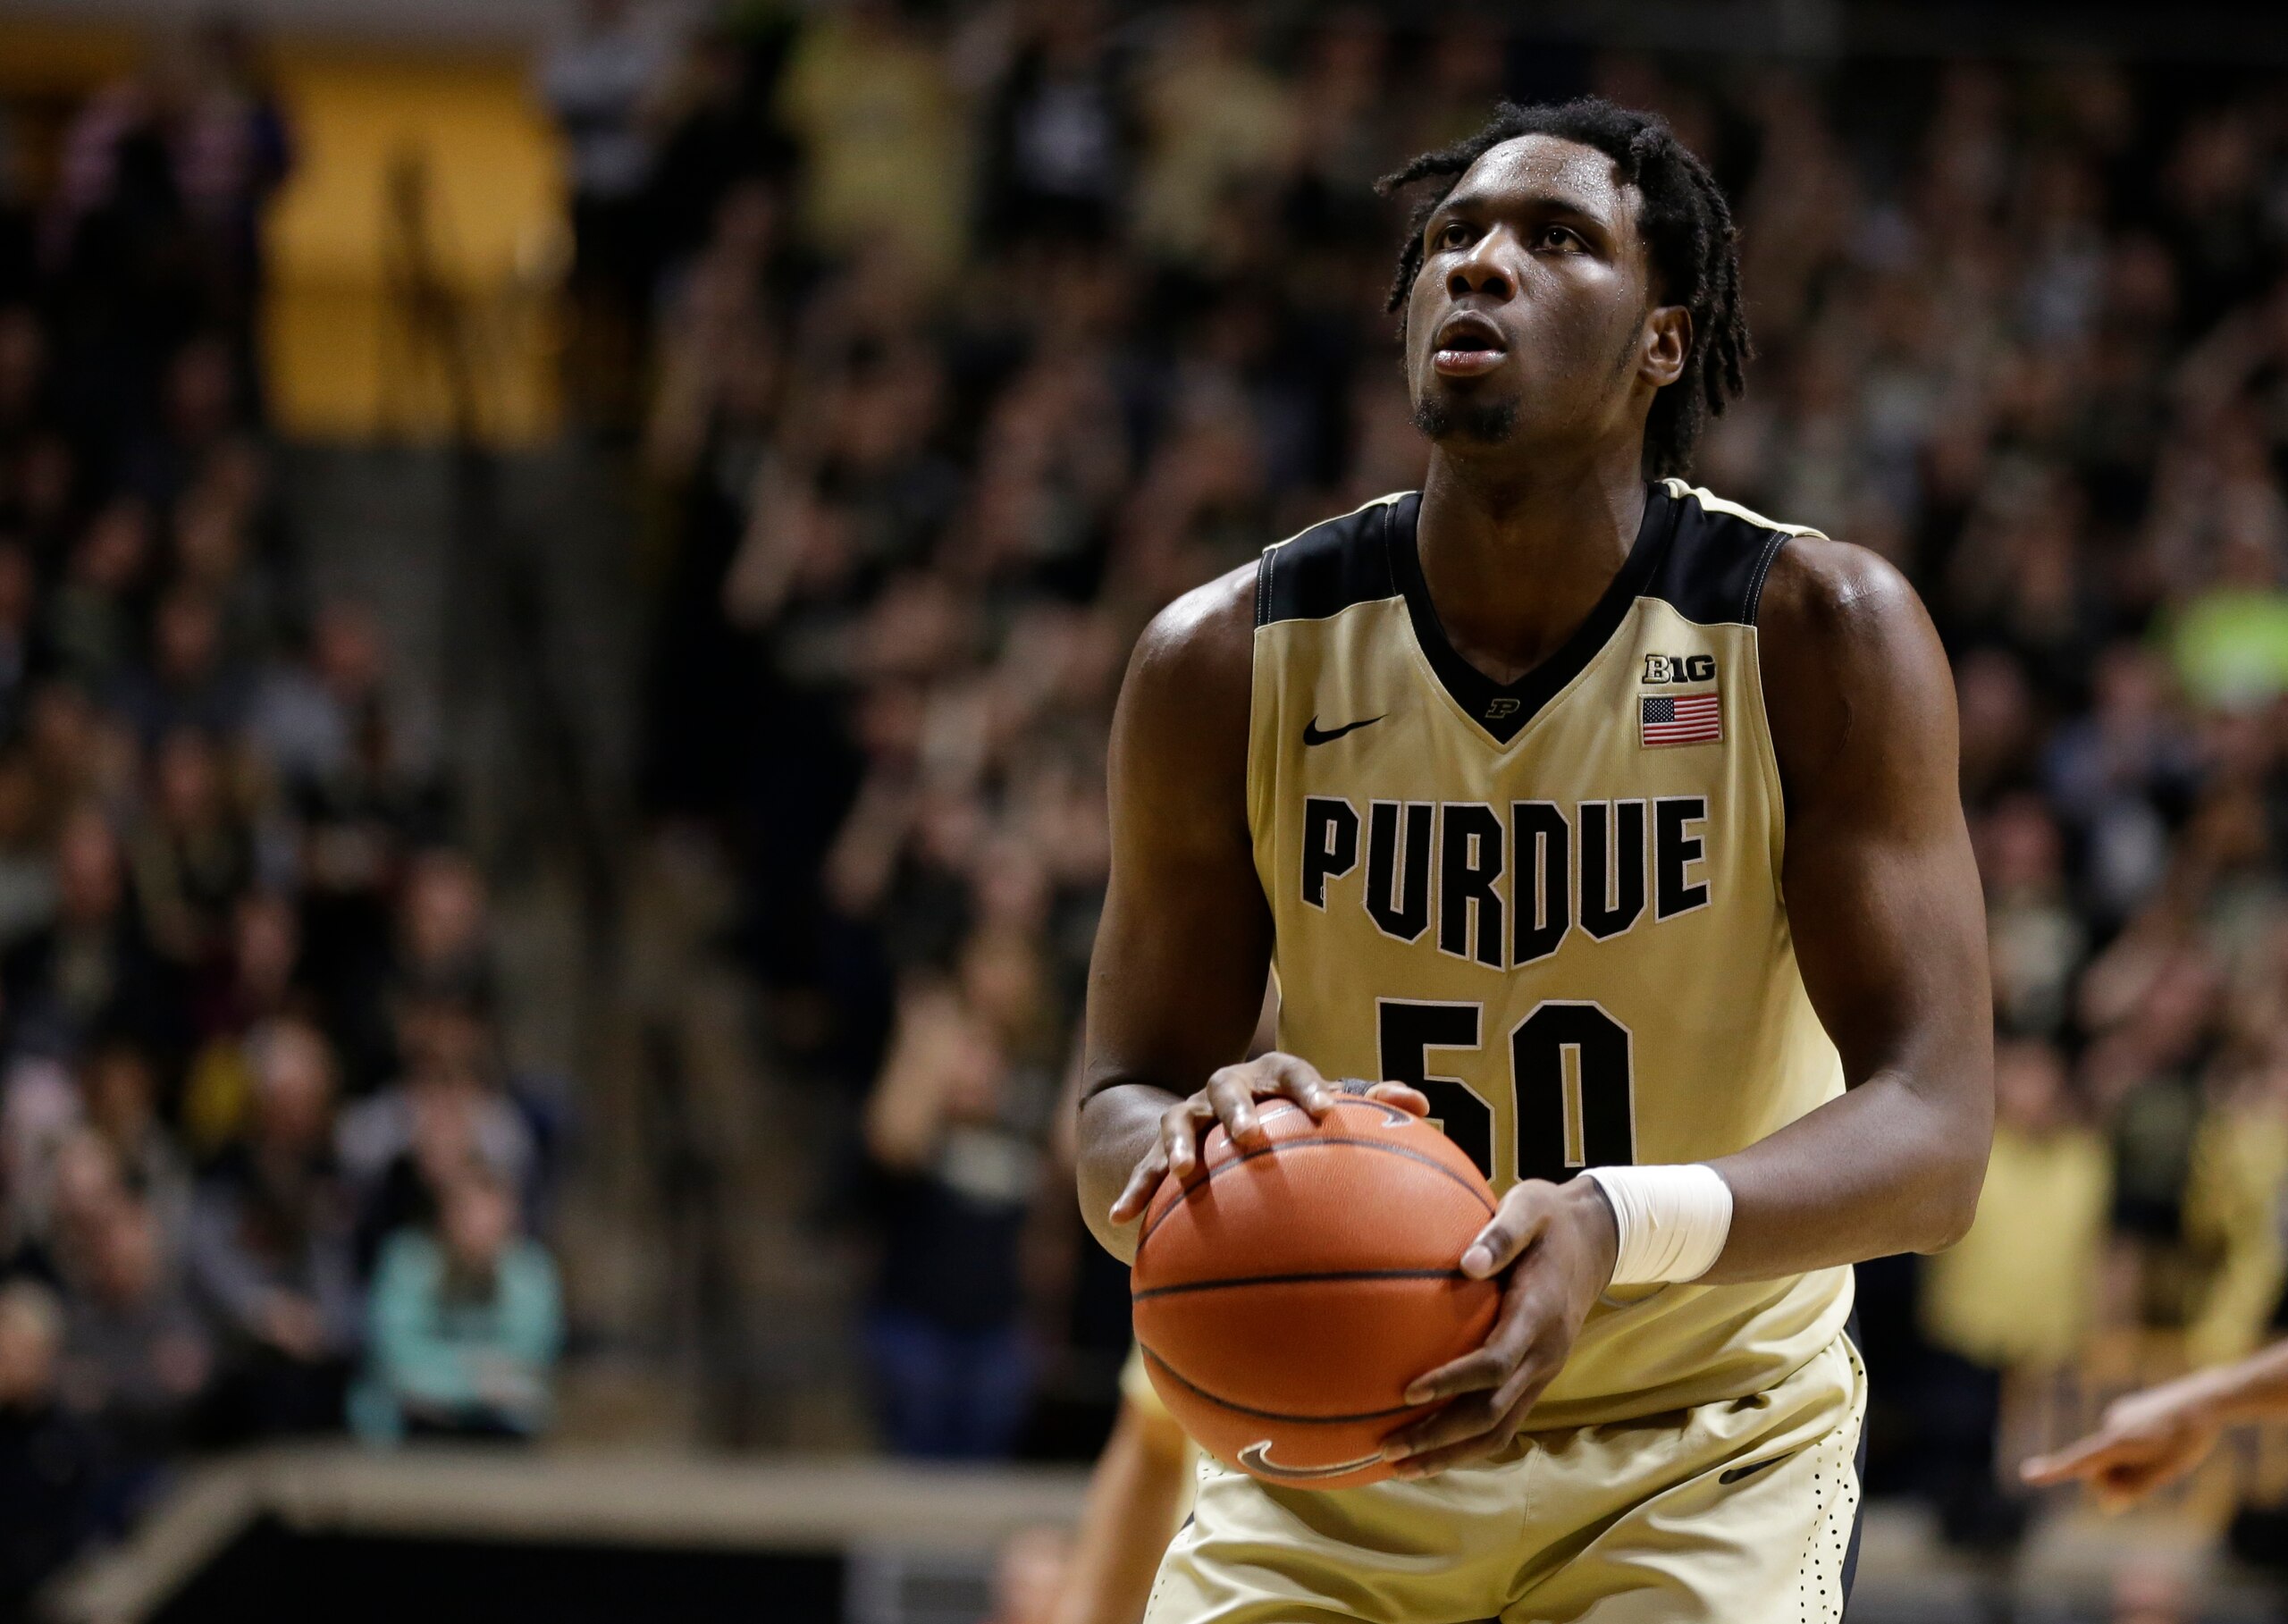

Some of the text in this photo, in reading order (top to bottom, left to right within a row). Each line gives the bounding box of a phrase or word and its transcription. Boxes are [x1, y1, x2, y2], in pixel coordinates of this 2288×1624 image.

[1485, 698, 1520, 719] P
[1300, 795, 1712, 972] PURDUE
[1375, 997, 1637, 1185] 50
